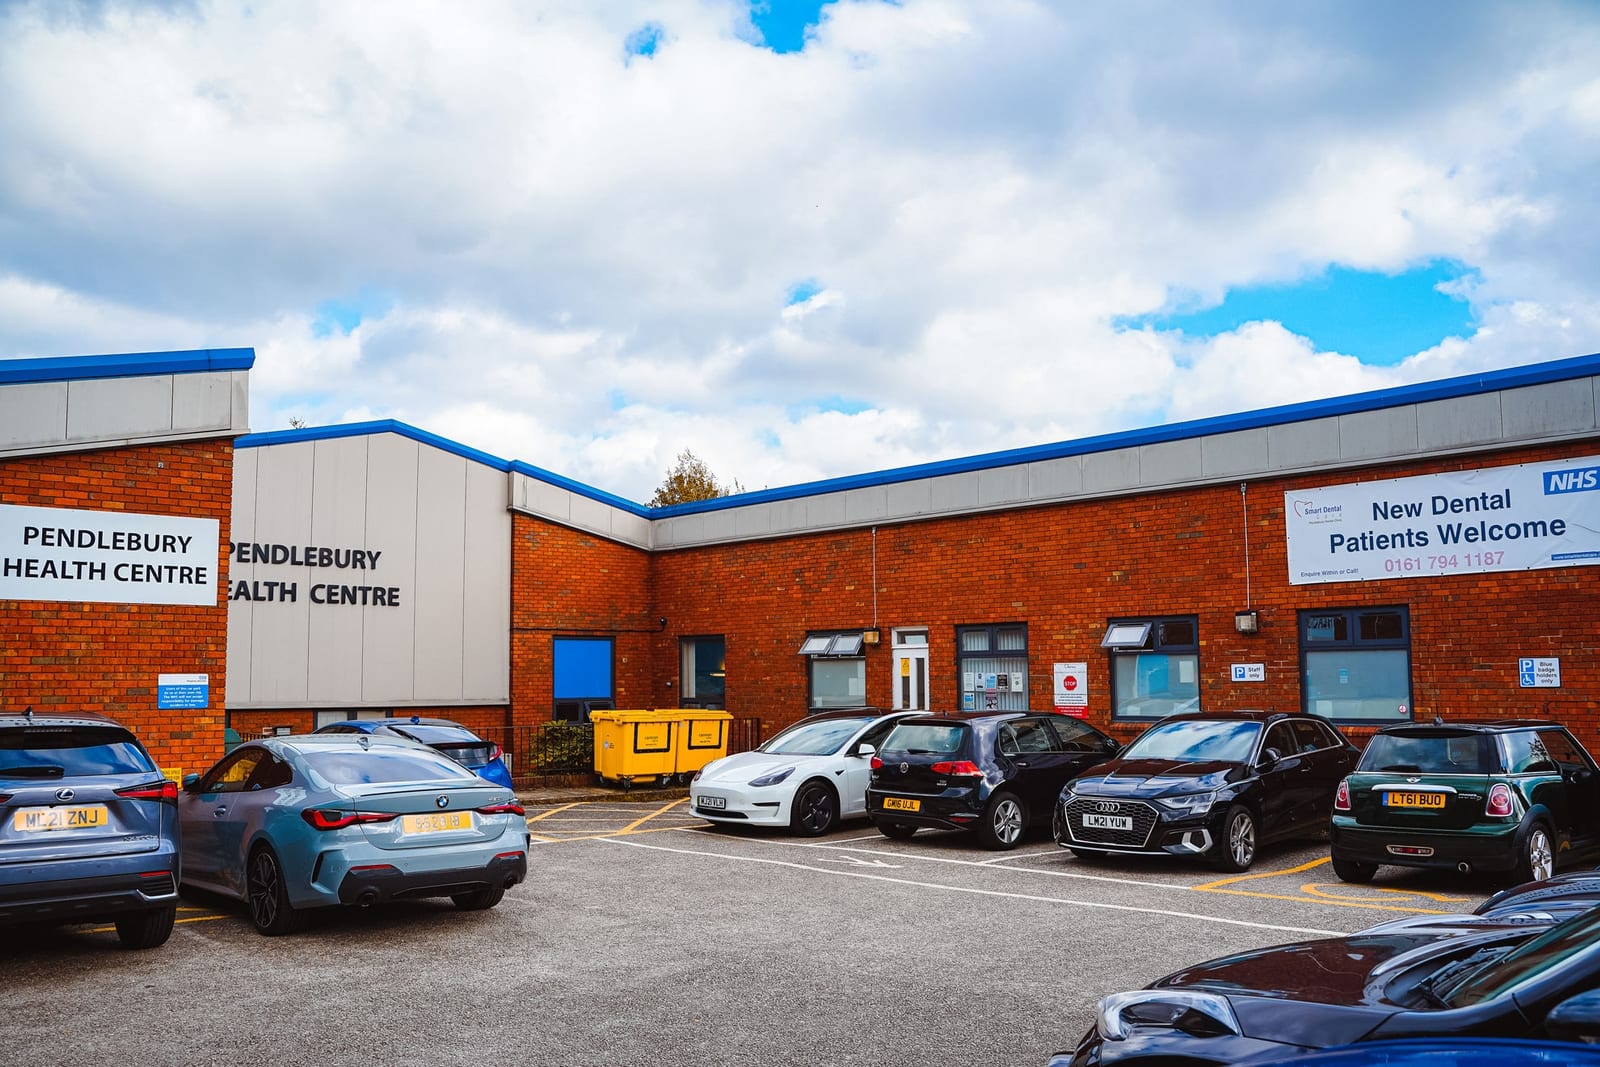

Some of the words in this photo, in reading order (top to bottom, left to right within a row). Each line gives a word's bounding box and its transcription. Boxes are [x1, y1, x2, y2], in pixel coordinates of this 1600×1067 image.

[1549, 470, 1598, 491] NHS
[1304, 506, 1322, 515] Smart
[1323, 504, 1342, 513] Dental
[1372, 501, 1423, 521] New
[1431, 488, 1512, 516] Dental
[23, 526, 192, 554] PENDLEBURY
[1330, 527, 1429, 553] Patients
[1437, 518, 1566, 545] Welcome
[3, 557, 107, 581] HEALTH
[113, 563, 208, 585] CENTRE
[1384, 557, 1421, 573] 0161
[1427, 554, 1459, 570] 794
[1465, 551, 1505, 568] 1187
[310, 583, 400, 607] CENTRE
[902, 800, 915, 809] UJL
[1392, 793, 1416, 805] LT61
[1419, 795, 1441, 806] BUO
[68, 810, 98, 825] ZNJ
[1088, 815, 1108, 826] LM21
[1109, 817, 1127, 828] YUW
